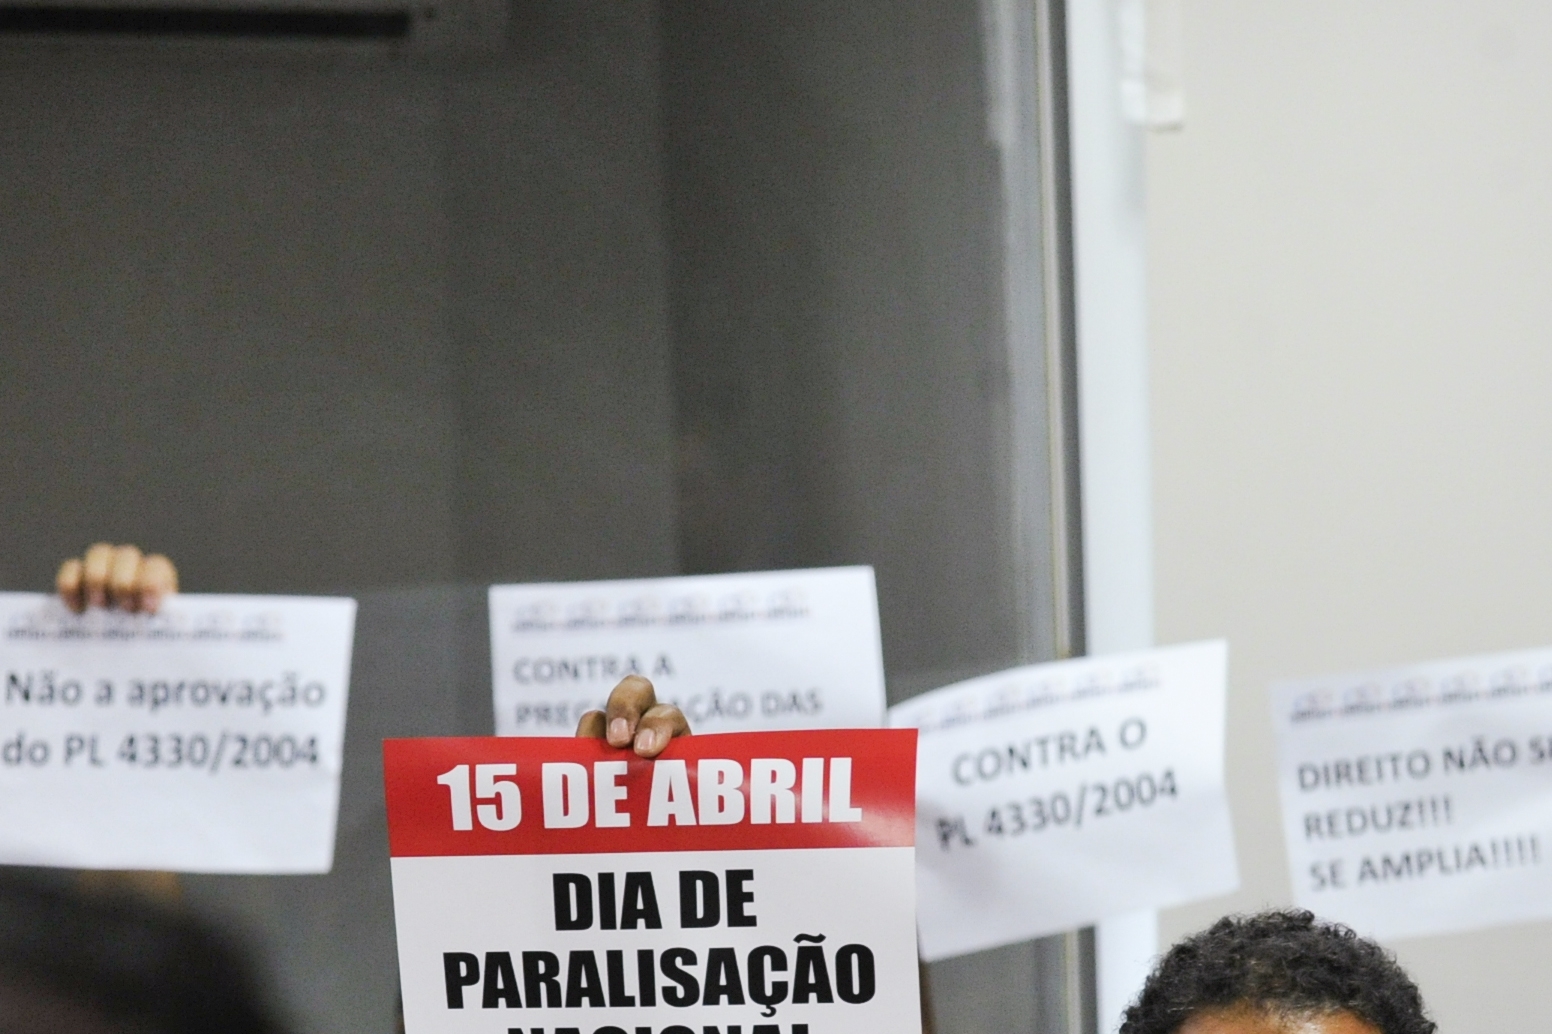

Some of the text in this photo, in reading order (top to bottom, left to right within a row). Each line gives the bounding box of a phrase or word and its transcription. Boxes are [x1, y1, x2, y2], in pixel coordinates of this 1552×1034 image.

[5, 671, 327, 715] Não a aprovação
[512, 652, 676, 685] CONTRA A
[761, 689, 823, 717] DAS
[2, 732, 321, 775] do PL 4330/2004
[951, 717, 1148, 787] CONTRA O
[1298, 749, 1432, 793] DIREITO
[1442, 735, 1518, 775] NÃO
[436, 756, 863, 831] 15 DE ABRIL
[935, 769, 1179, 853] PL 4330/2004
[1304, 795, 1453, 842] REDUZ!!!
[1309, 833, 1541, 892] SE AMPLIA!!!!
[552, 868, 757, 931] DIA DE
[442, 933, 876, 1018] PARALISAÇÃO
